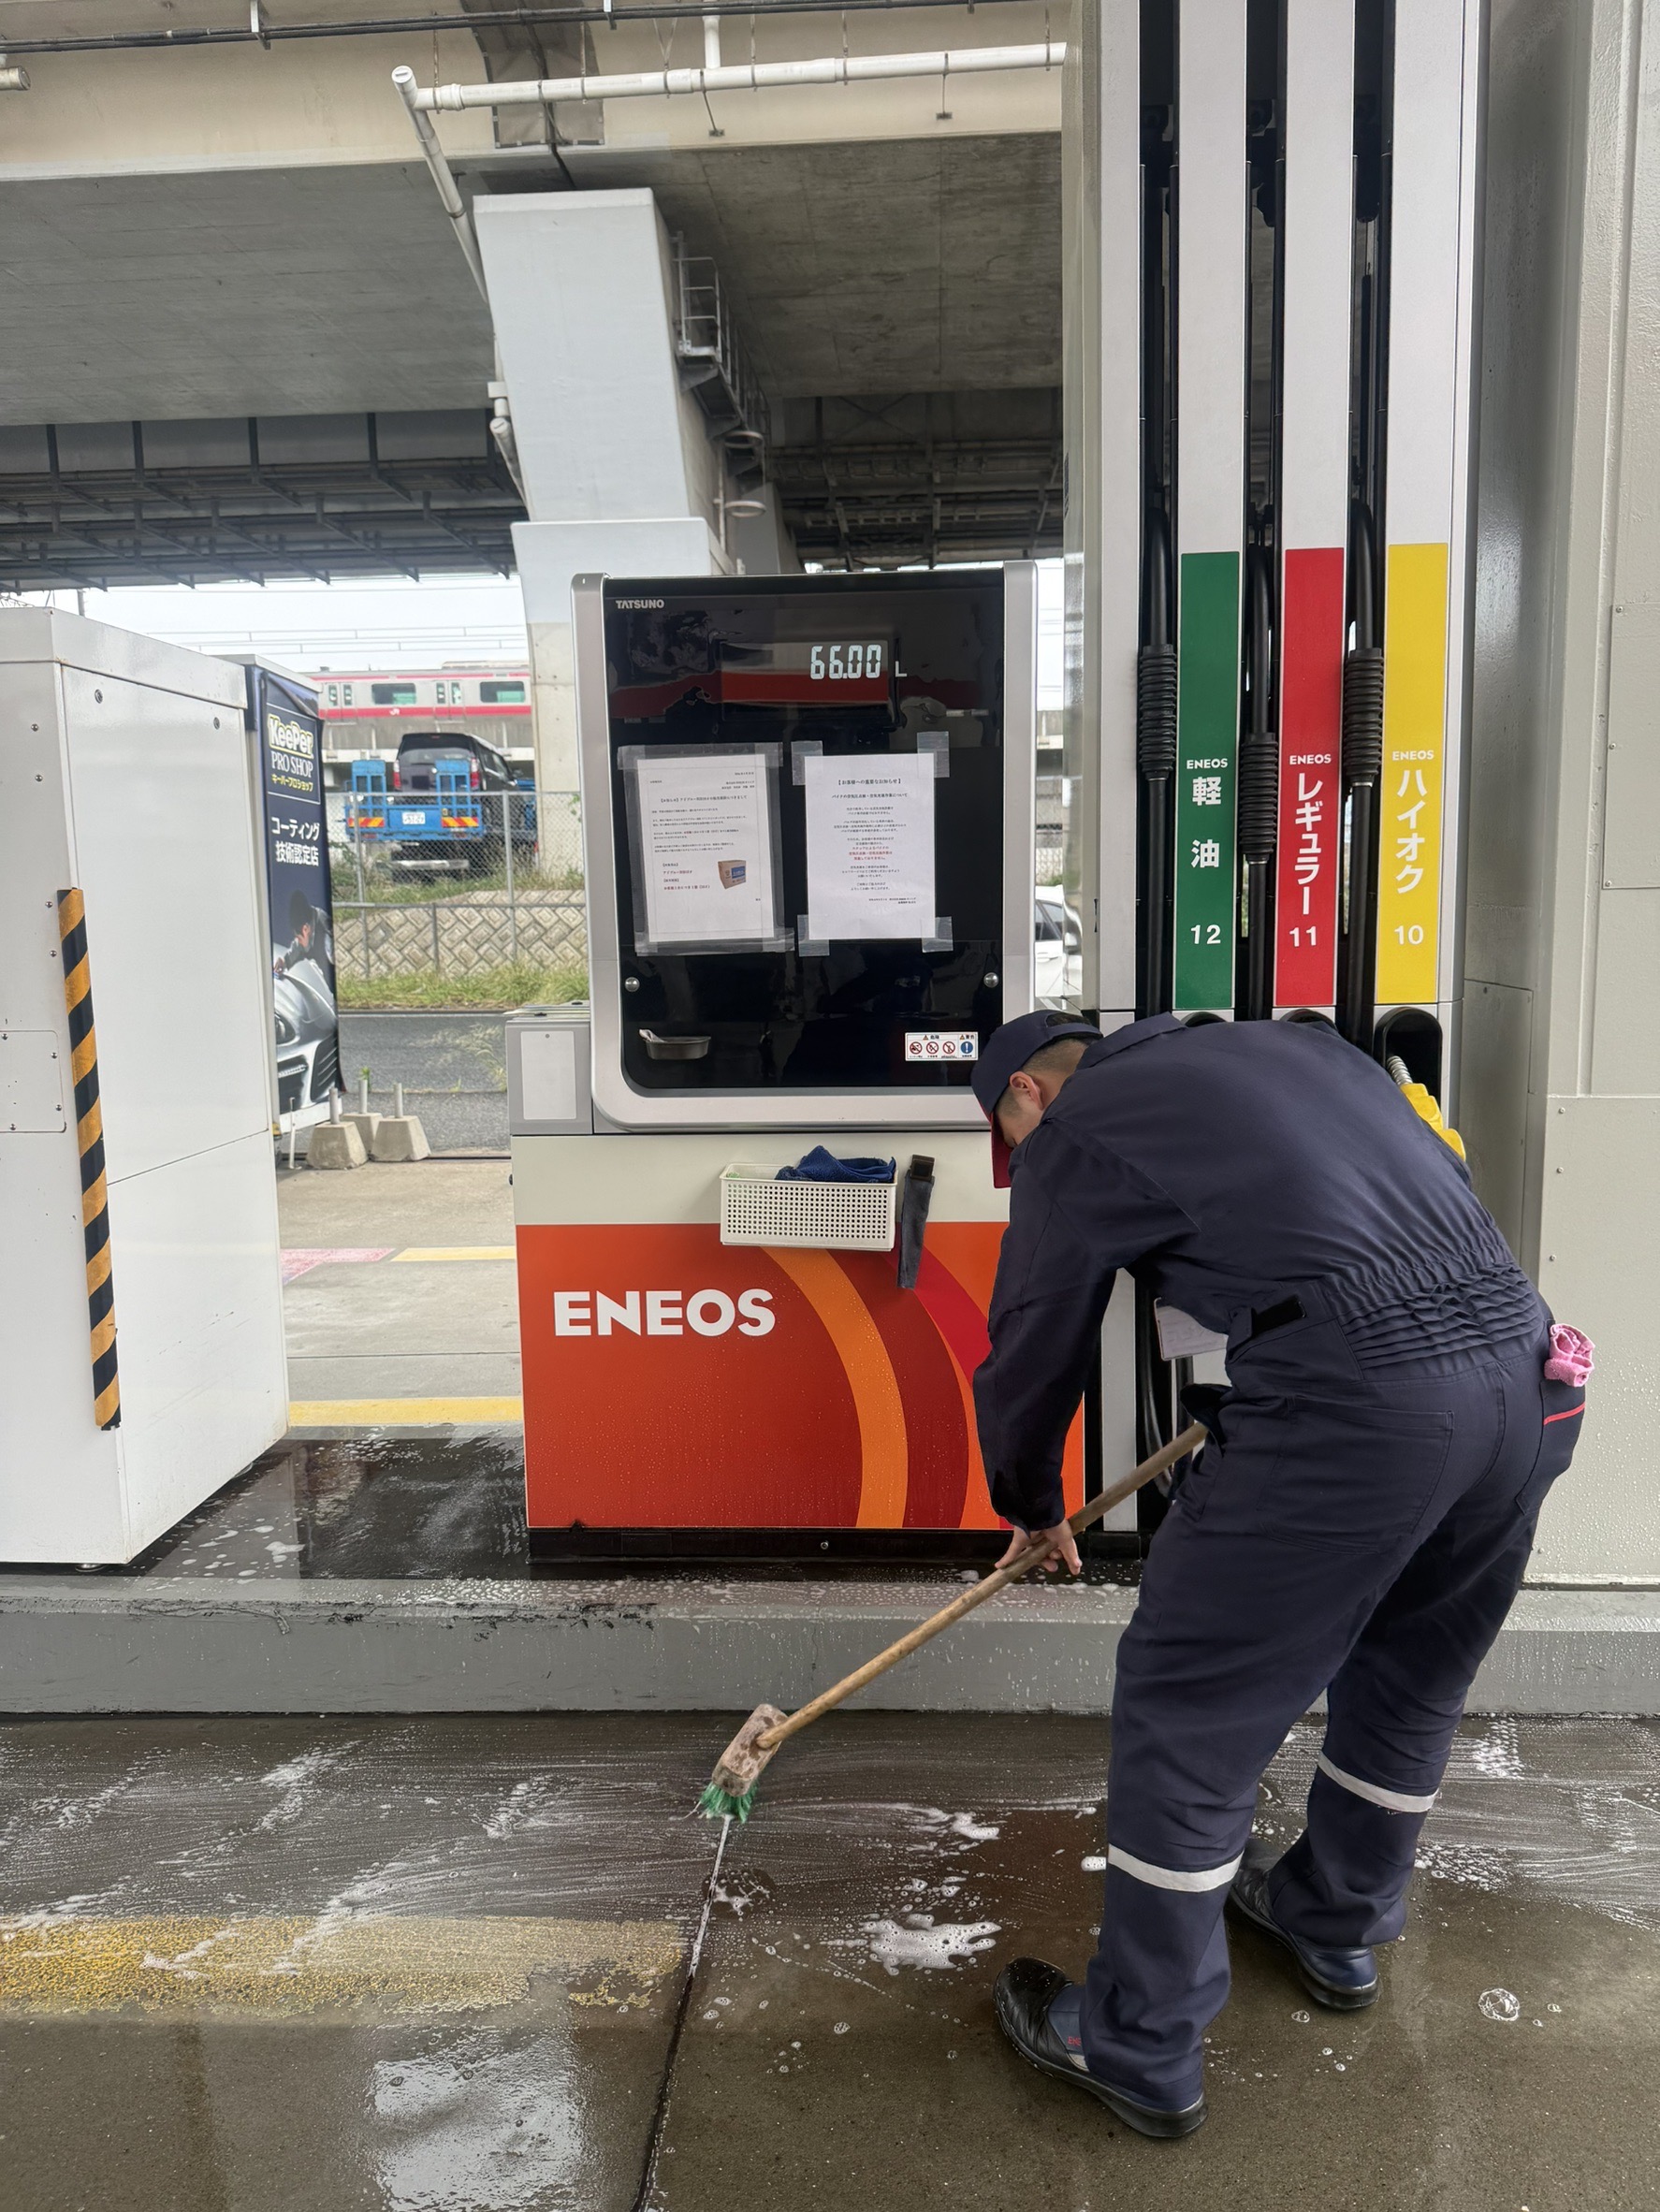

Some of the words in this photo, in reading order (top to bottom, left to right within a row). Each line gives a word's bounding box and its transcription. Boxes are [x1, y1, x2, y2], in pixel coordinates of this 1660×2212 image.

[616, 599, 664, 609] TATSUNO
[809, 644, 881, 680] 66.00
[896, 661, 908, 677] L
[268, 714, 313, 755] KeePer
[270, 749, 291, 776] PRO
[291, 755, 313, 779] SHOP
[1187, 758, 1229, 770] ENEOS
[1289, 753, 1332, 765] ENEOS
[1392, 749, 1434, 762] ENEOS
[271, 773, 313, 793] キーパープロショップ
[271, 816, 320, 842] コーティング
[1190, 776, 1222, 868] 軽油
[1395, 769, 1428, 895] ハイオク
[275, 840, 319, 867] 技術認定店
[1294, 773, 1324, 916] レギュラー
[1191, 924, 1222, 945] 12
[1289, 925, 1318, 947] 11
[1394, 924, 1424, 946] 10
[553, 1288, 776, 1337] ENEOS
